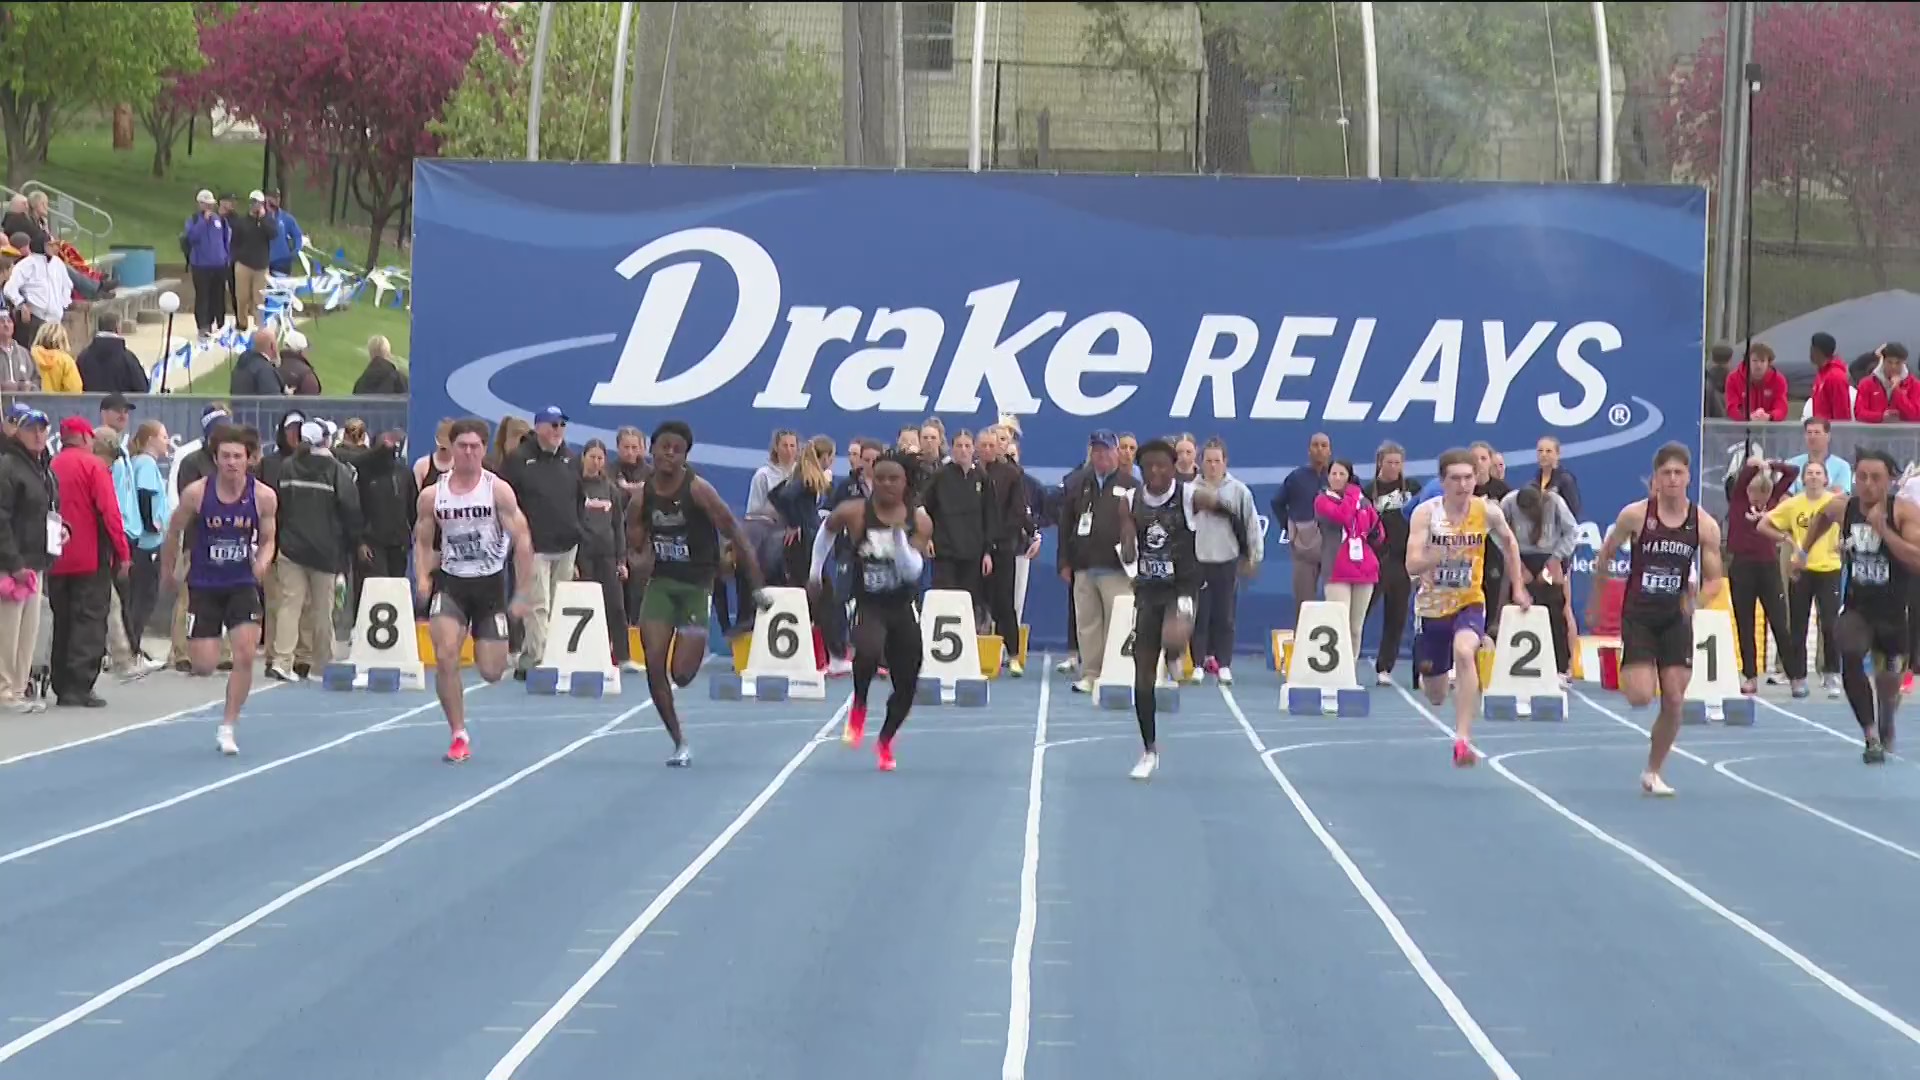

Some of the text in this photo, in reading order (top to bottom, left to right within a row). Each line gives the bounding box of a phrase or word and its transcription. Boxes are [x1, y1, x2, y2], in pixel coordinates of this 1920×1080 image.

[589, 227, 1153, 416] Drake
[1169, 313, 1622, 426] RELAYS
[1431, 533, 1483, 546] NEVADA
[367, 603, 399, 650] 8
[562, 607, 595, 653] 7
[767, 612, 799, 659] 6
[931, 615, 963, 663] 5
[1307, 625, 1340, 673] 3
[1509, 630, 1542, 677] 2
[1695, 634, 1717, 682] 1
